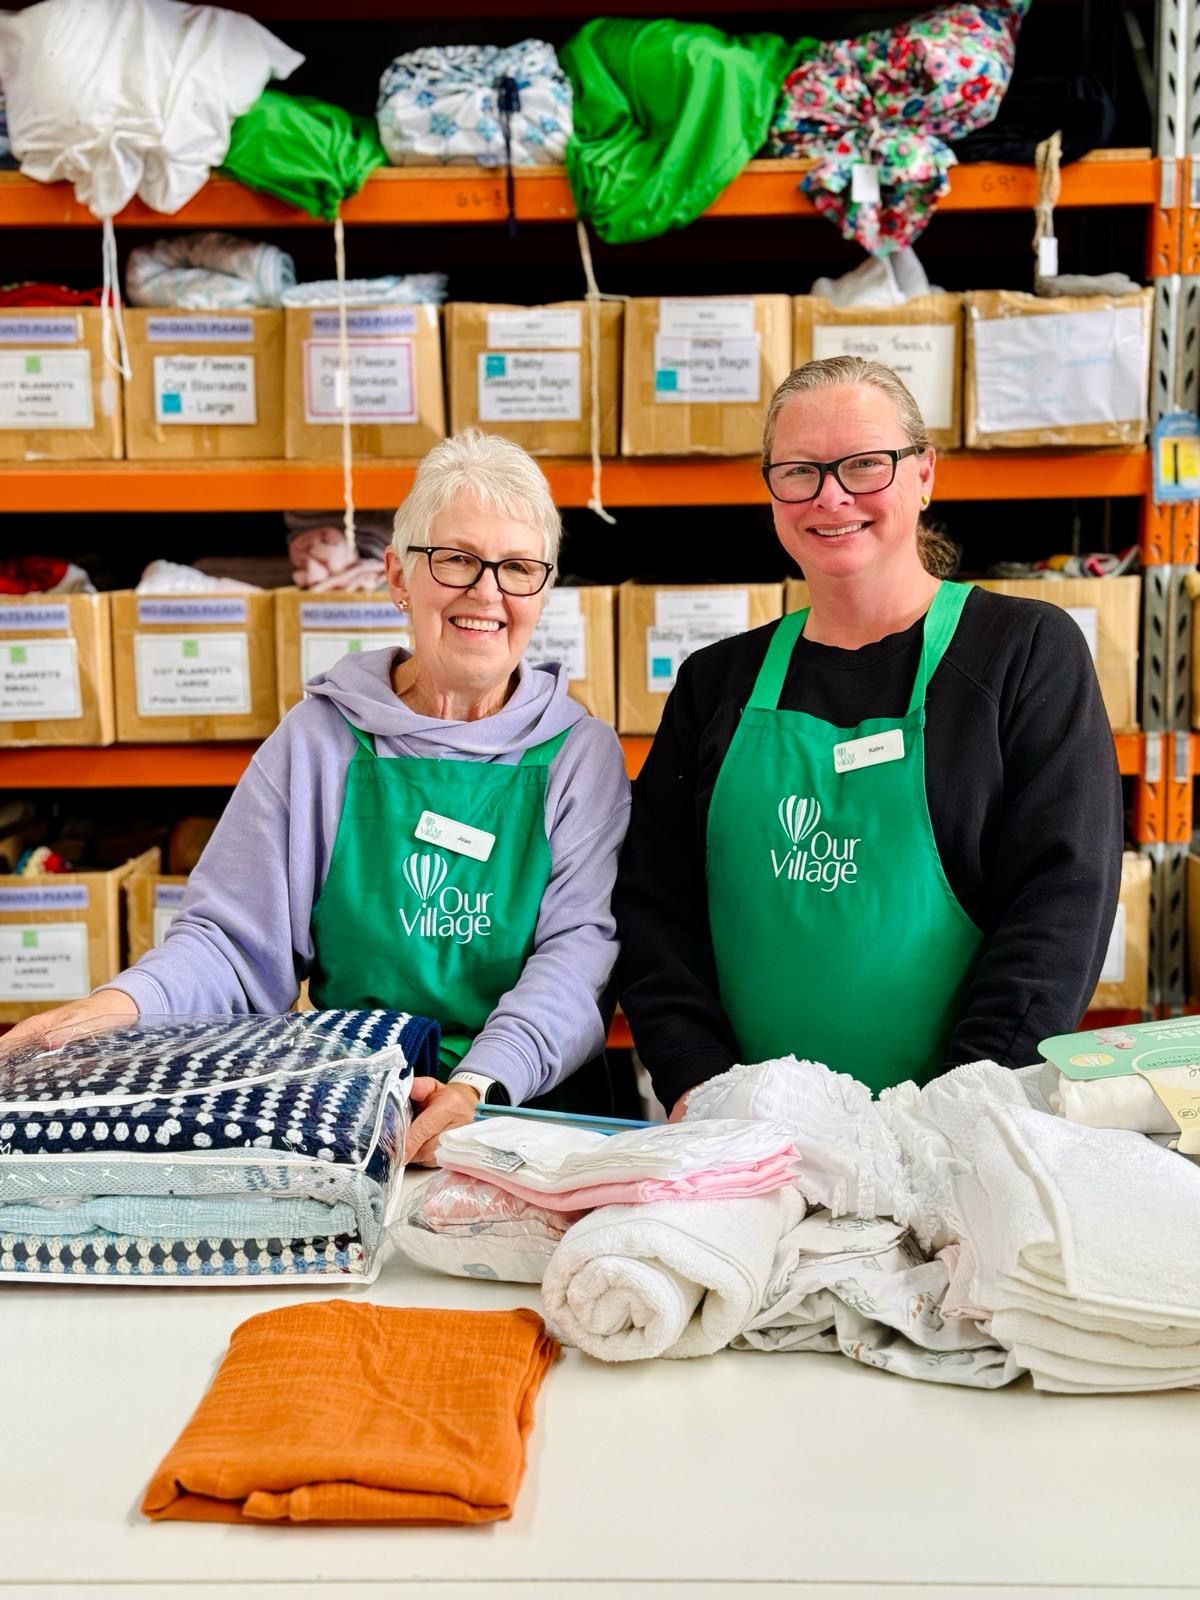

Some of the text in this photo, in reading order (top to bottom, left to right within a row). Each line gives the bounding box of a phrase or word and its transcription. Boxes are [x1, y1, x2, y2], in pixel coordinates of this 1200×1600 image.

[169, 323, 207, 334] QUILTS
[211, 323, 250, 334] PLEASE
[163, 359, 247, 371] Polar Fleece
[356, 356, 396, 367] Fleece
[513, 358, 544, 371] Baby
[660, 357, 751, 371] Sleeping Bags
[20, 381, 75, 390] BLANKETS
[190, 380, 247, 391] Blankets
[541, 376, 572, 390] Bags
[18, 393, 52, 403] LARGE
[353, 394, 386, 406] Small
[197, 400, 235, 416] Large
[323, 607, 361, 619] QUILTS
[650, 627, 683, 644] Baby
[4, 671, 61, 681] BLANKETS
[177, 666, 231, 676] BLANKETS
[4, 684, 38, 693] SMALL
[175, 679, 209, 689] LARGE
[810, 831, 862, 861] Our
[770, 849, 858, 892] Village
[43, 891, 84, 901] PLEASE
[439, 886, 494, 915] Our
[399, 907, 491, 945] Village
[16, 954, 71, 963] BLANKETS
[14, 967, 49, 976] LARGE
